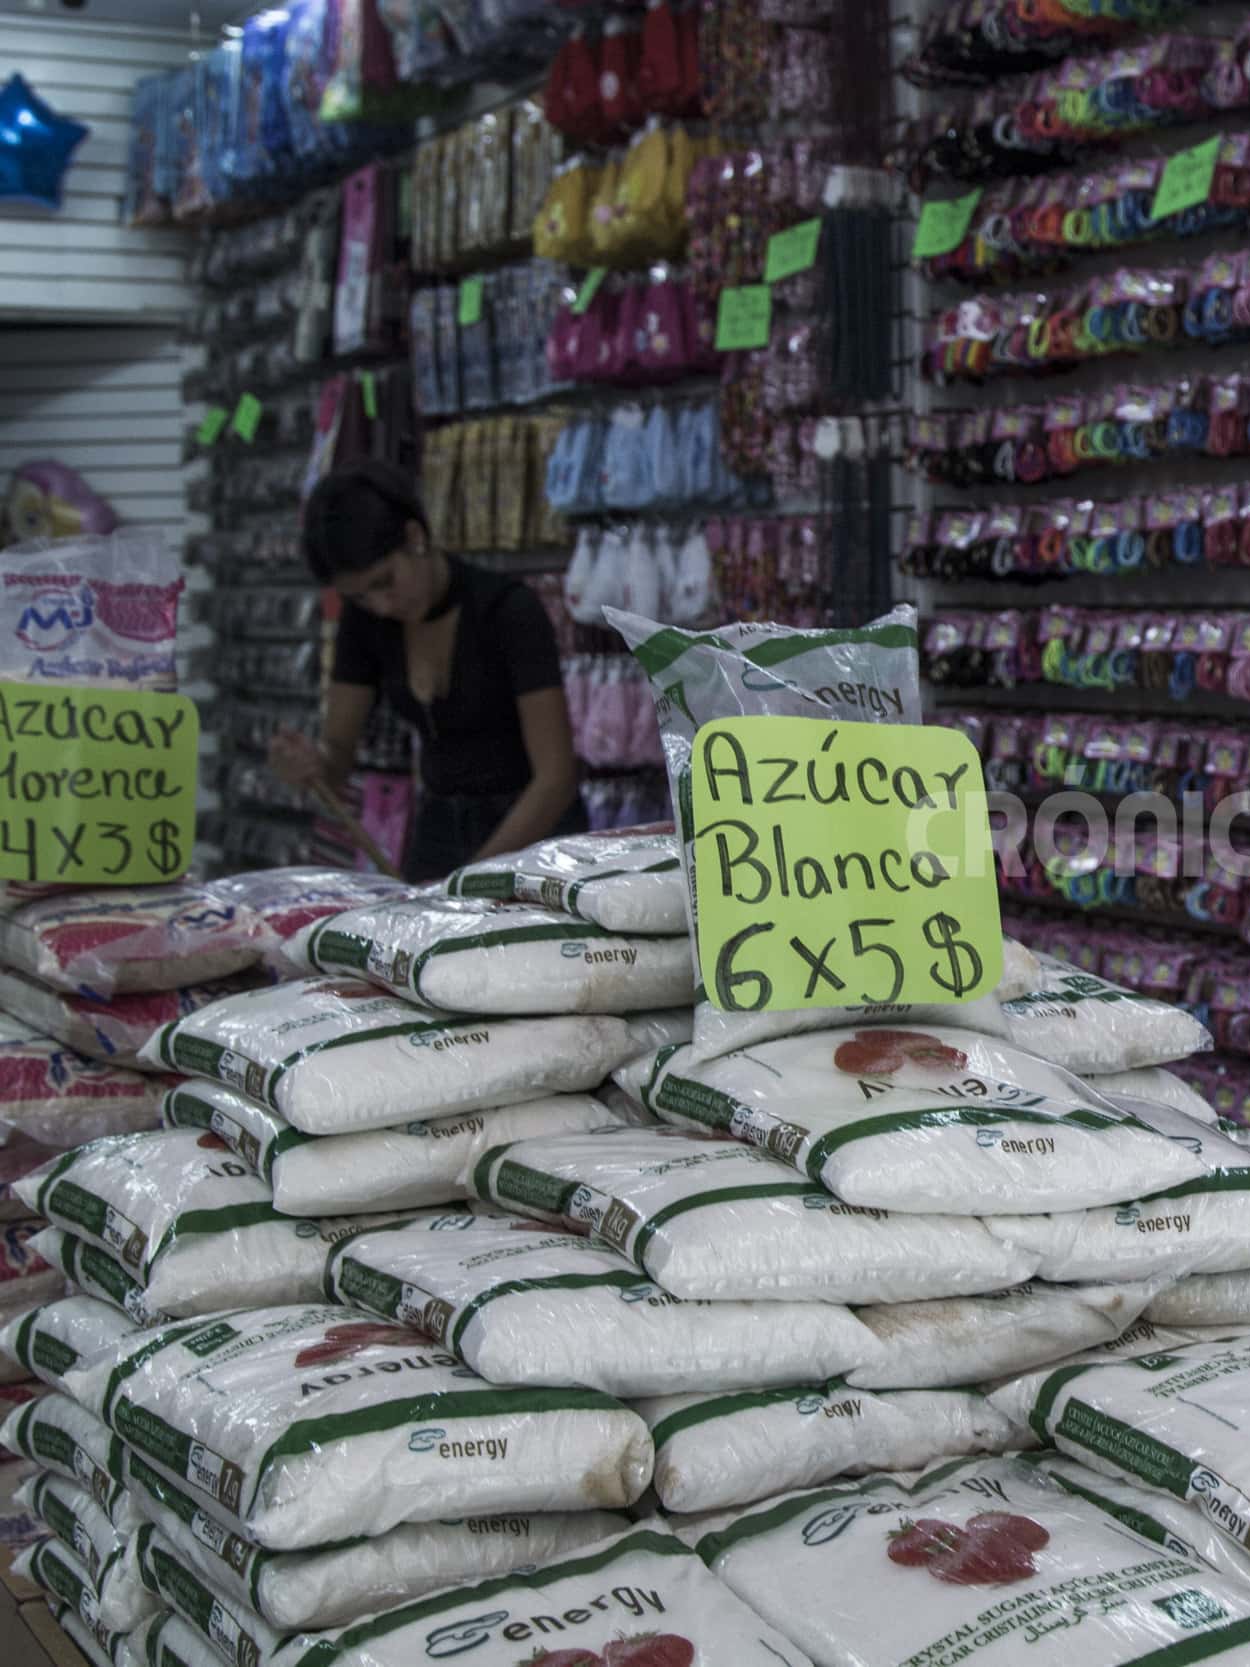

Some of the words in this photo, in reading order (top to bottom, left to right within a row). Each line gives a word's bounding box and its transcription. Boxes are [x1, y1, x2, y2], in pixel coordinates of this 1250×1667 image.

[703, 729, 969, 810] Azúcar
[696, 818, 952, 905] Blanca
[584, 945, 638, 965] energy
[432, 1028, 490, 1052] energy
[430, 1115, 486, 1141] energy
[1001, 1134, 1056, 1155] energy
[606, 1204, 629, 1242] 1kg
[1136, 1211, 1192, 1234] energy
[1103, 1320, 1159, 1351] energy
[439, 1437, 509, 1460] energy
[467, 1516, 531, 1536] energy
[502, 1586, 668, 1643] energy
[898, 1623, 979, 1667] RYSTAL
[977, 1589, 1041, 1626] SUGAR
